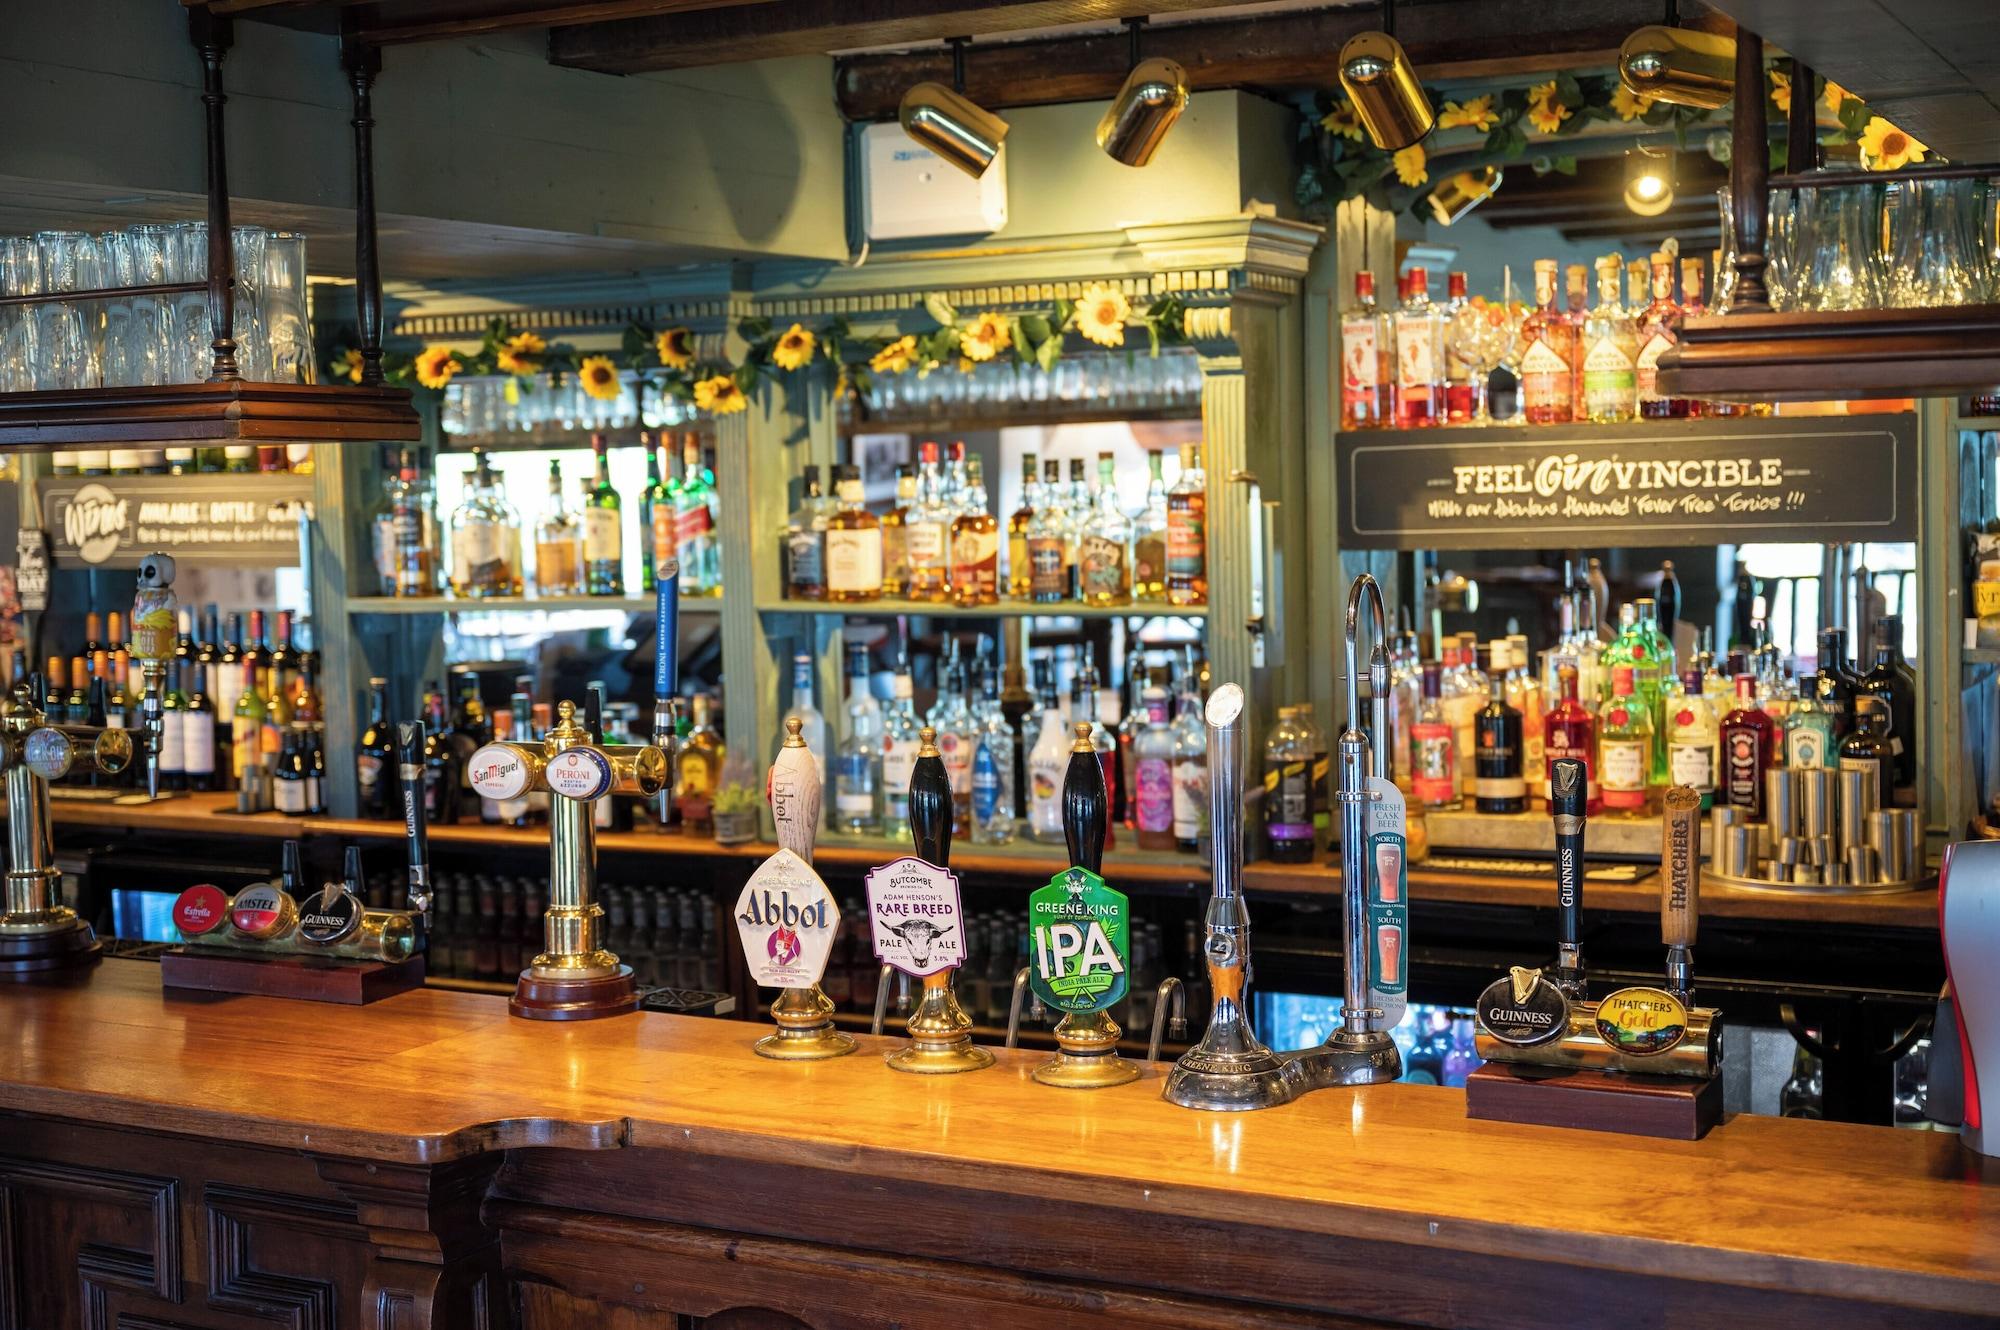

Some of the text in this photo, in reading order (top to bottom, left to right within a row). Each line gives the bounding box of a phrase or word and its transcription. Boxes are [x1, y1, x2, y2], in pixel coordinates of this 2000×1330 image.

[1453, 464, 1533, 494] FEEL
[1613, 457, 1782, 490] VINCIBLE
[1427, 499, 1462, 519] With
[1465, 502, 1492, 518] our
[1493, 497, 1558, 519] fabulous
[657, 652, 667, 685] PERONI
[556, 768, 591, 781] PERONI
[774, 762, 799, 823] Abbot
[404, 790, 416, 837] GUINNESS
[1374, 803, 1401, 812] FRESH
[1375, 811, 1400, 820] CASK
[1378, 820, 1398, 828] BEER
[1375, 835, 1401, 843] NORTH
[1669, 818, 1689, 913] THATCHERS
[889, 876, 933, 889] BUTCOMBE
[1561, 848, 1574, 907] GUINNESS
[236, 898, 277, 910] AMSTEL
[906, 894, 943, 902] HENSON'S
[184, 905, 211, 918] Estrella
[740, 888, 829, 929] Abbot
[876, 903, 953, 918] RARE BREED
[1036, 902, 1119, 916] GREENE KING
[304, 913, 345, 926] GUINNESS
[880, 939, 957, 949] PALE ALE
[1035, 921, 1124, 979] IPA
[1058, 976, 1105, 988] INDIA PALE ALE
[1613, 999, 1672, 1013] THATCHERS
[1489, 1007, 1553, 1025] GUINNESS
[1619, 1010, 1659, 1029] Gold
[1181, 1059, 1252, 1073] GREENE KING
